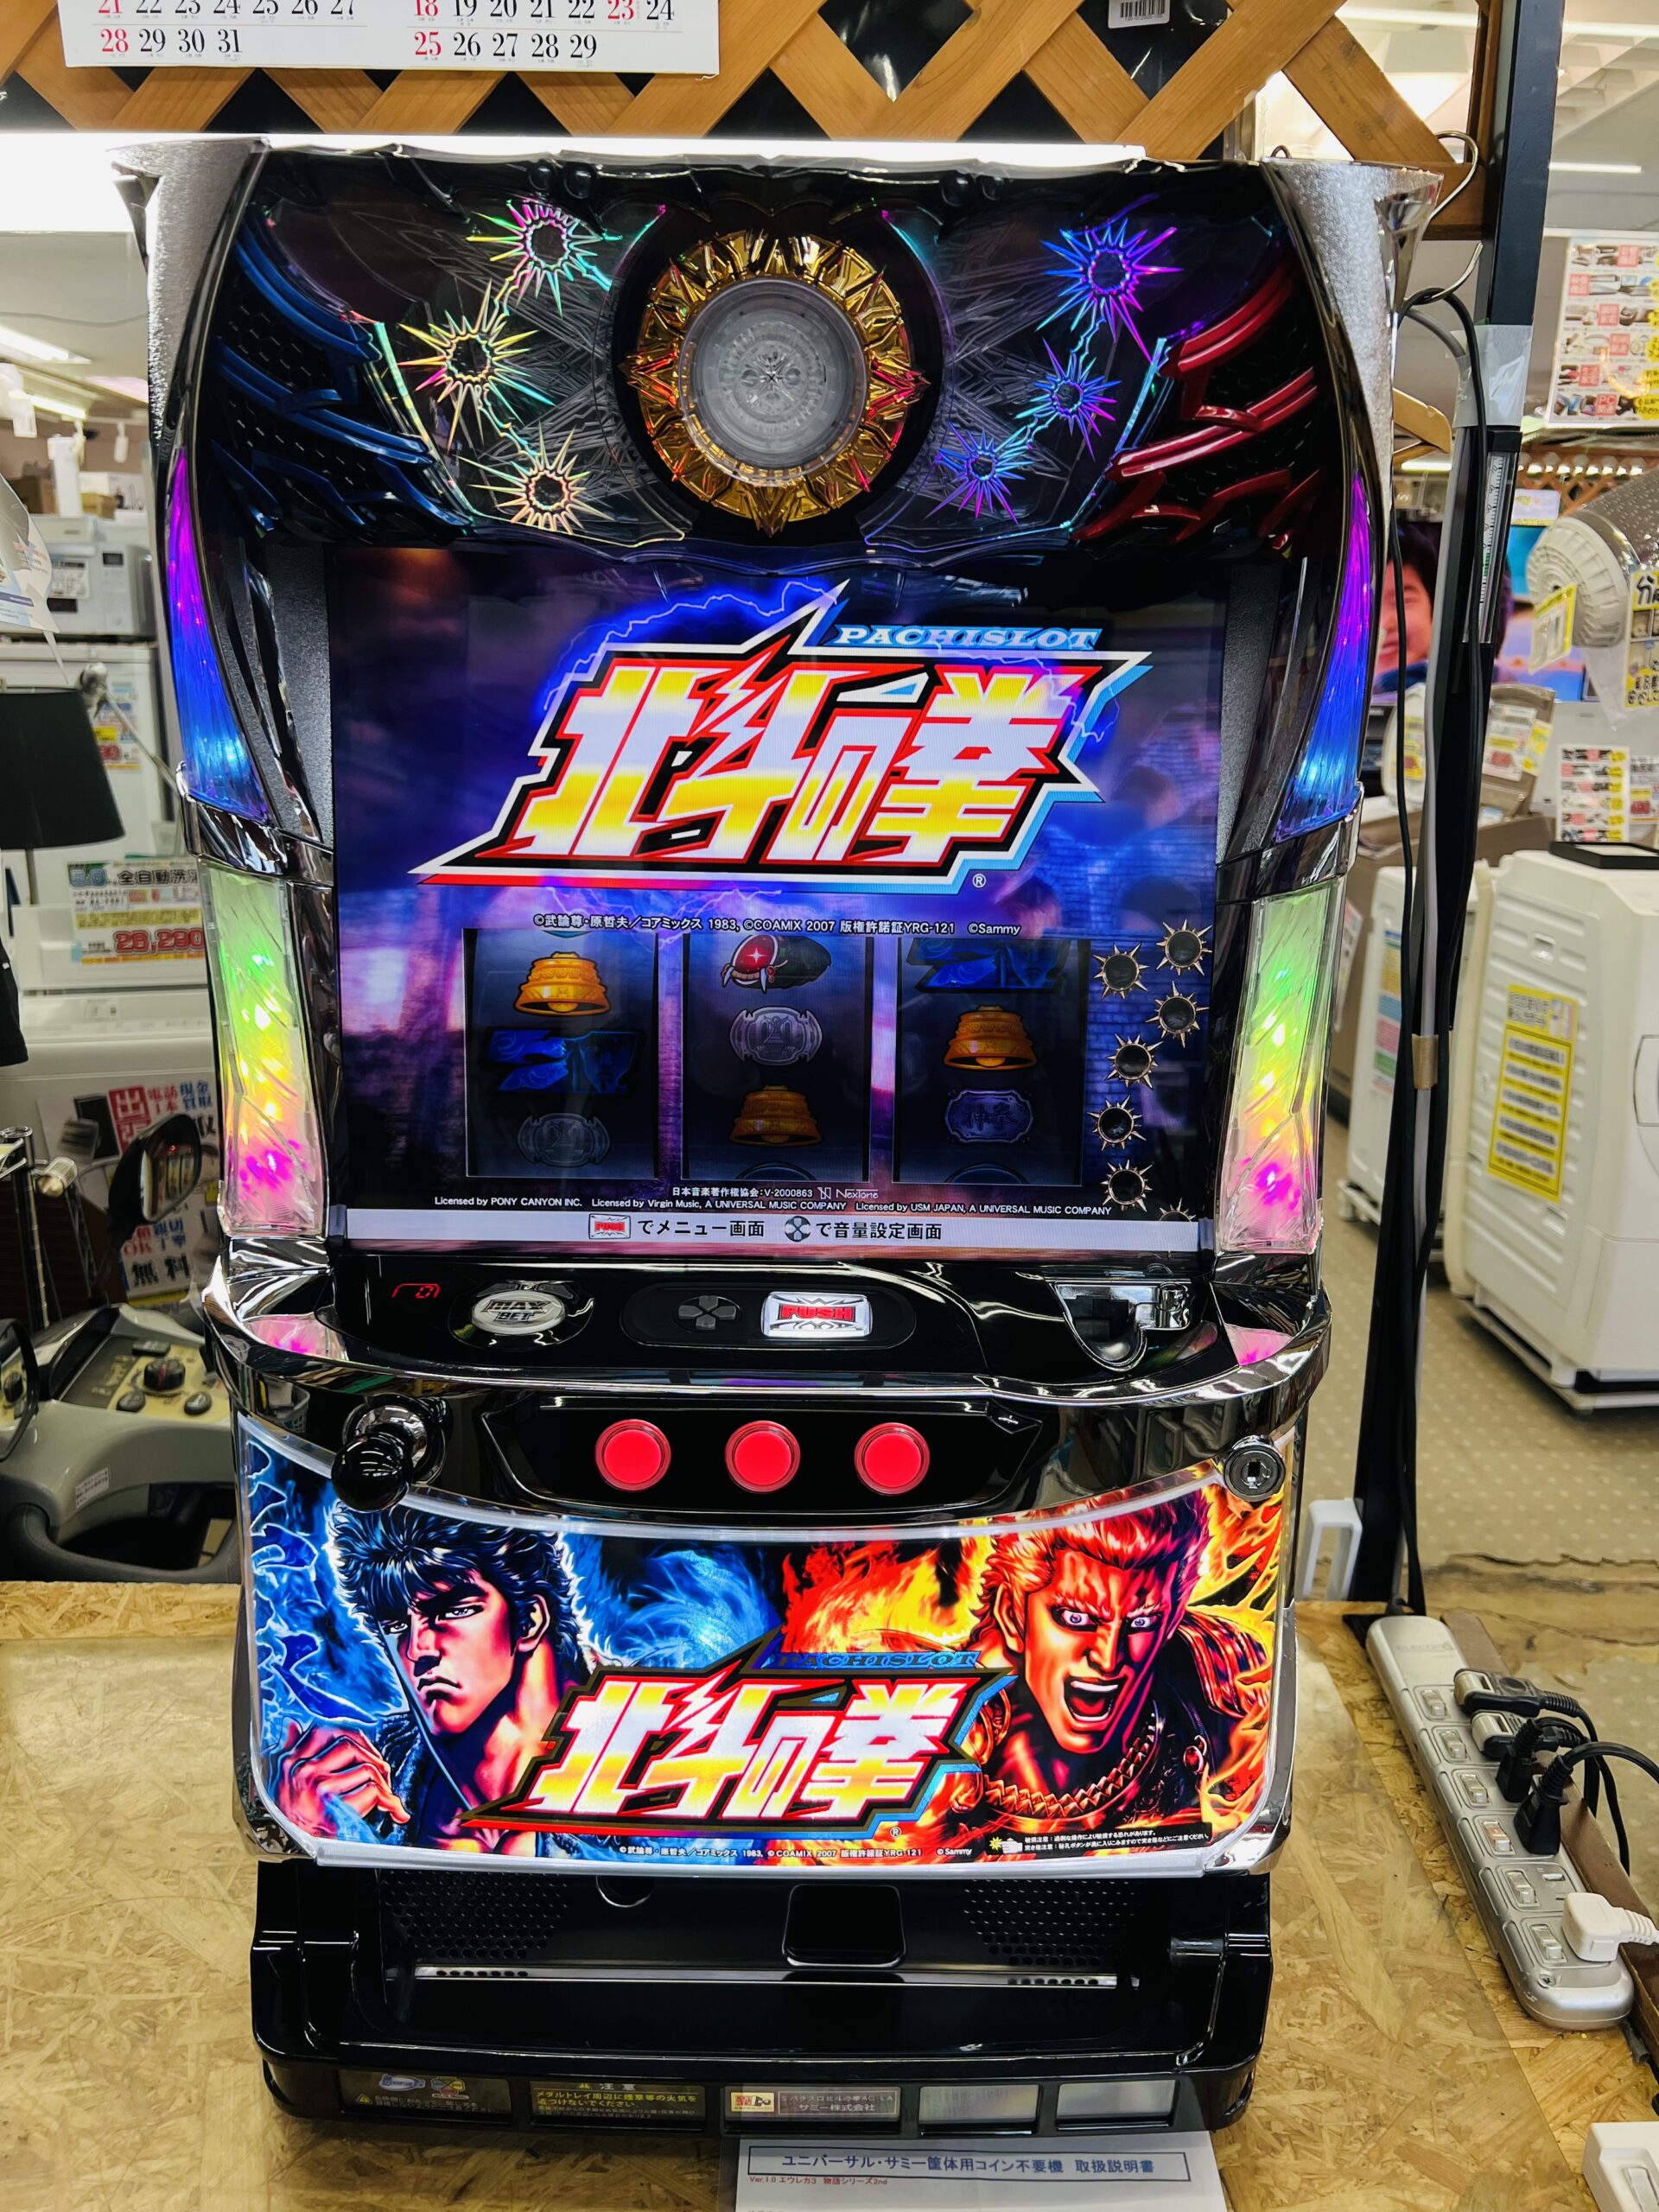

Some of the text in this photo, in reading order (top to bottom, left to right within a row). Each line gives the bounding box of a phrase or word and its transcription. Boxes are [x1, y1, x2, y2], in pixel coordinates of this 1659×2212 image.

[413, 0, 675, 21] 18 19 20 21 22 23 24
[99, 29, 244, 53] 28 29 30 31
[414, 31, 598, 59] 25 26 27 28 29
[832, 626, 1103, 648] PACHISLOT
[505, 648, 1099, 864] 北斗の拳
[709, 918, 741, 931] 1983,
[743, 919, 802, 931] ©COAMIX
[807, 919, 836, 932] 2007
[968, 923, 1021, 936] ©Sammy
[434, 1197, 474, 1206] Licensed
[477, 1197, 488, 1207] by
[491, 1198, 518, 1206] PONY
[520, 1198, 562, 1206] CANYON
[564, 1198, 583, 1207] INC.
[591, 1198, 631, 1208] Licensed
[633, 1198, 645, 1209] by
[647, 1198, 673, 1209] Virgin
[676, 1199, 702, 1210] Music,
[715, 1200, 766, 1209] UNIVERSAL
[769, 1201, 798, 1210] MUSIC
[800, 1201, 847, 1210] COMPANY
[855, 1202, 894, 1211] Licensed
[897, 1203, 908, 1212] by
[933, 1204, 966, 1214] JAPAN,
[969, 1205, 976, 1213] A
[979, 1205, 1031, 1214] UNIVERSAL
[1033, 1205, 1062, 1215] MUSIC
[1065, 1206, 1112, 1216] COMPANY
[638, 1218, 765, 1237] でメニュー画面
[816, 1221, 942, 1240] で音量設定画面
[480, 1299, 550, 1313] MAX
[779, 1305, 855, 1321] PUSH
[494, 1310, 535, 1322] BET
[778, 1651, 980, 1667] PACHISLOT
[523, 1663, 963, 1820] 北斗の拳
[798, 2103, 876, 2113] サミー株式会社
[1074, 2158, 1155, 2174] 取扱説明書
